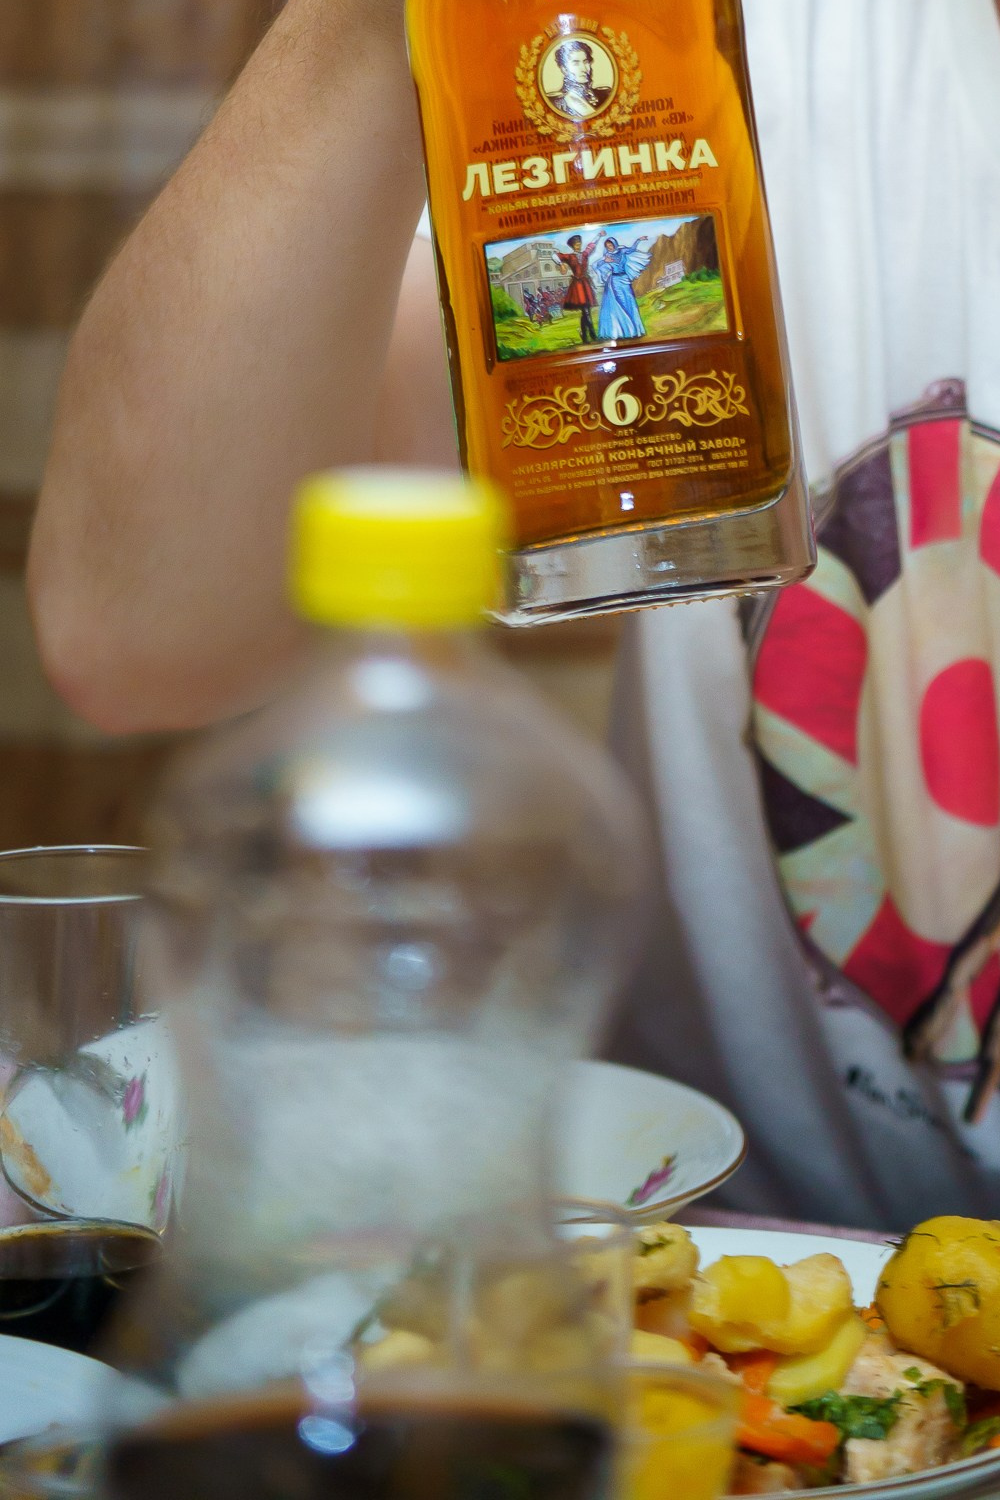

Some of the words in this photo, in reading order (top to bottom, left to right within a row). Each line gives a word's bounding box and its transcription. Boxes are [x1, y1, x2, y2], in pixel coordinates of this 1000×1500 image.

[462, 138, 719, 201] ЛЕЗГИНКА
[488, 199, 529, 215] КОНЬЯК
[530, 185, 620, 209] ВЫДЕРЖАННЫЙ
[638, 176, 701, 192] МАРОЧНЫЙ
[602, 375, 642, 426] 6
[512, 451, 606, 476] «КИЗЛЯРСКИЙ
[608, 439, 697, 462] КОНЬЯЧНЫЙ
[699, 437, 746, 452] ЗАВОД»
[573, 437, 634, 453] АКЦИОНЕРНОЕ
[636, 433, 682, 446] ОБЩЕСТВО
